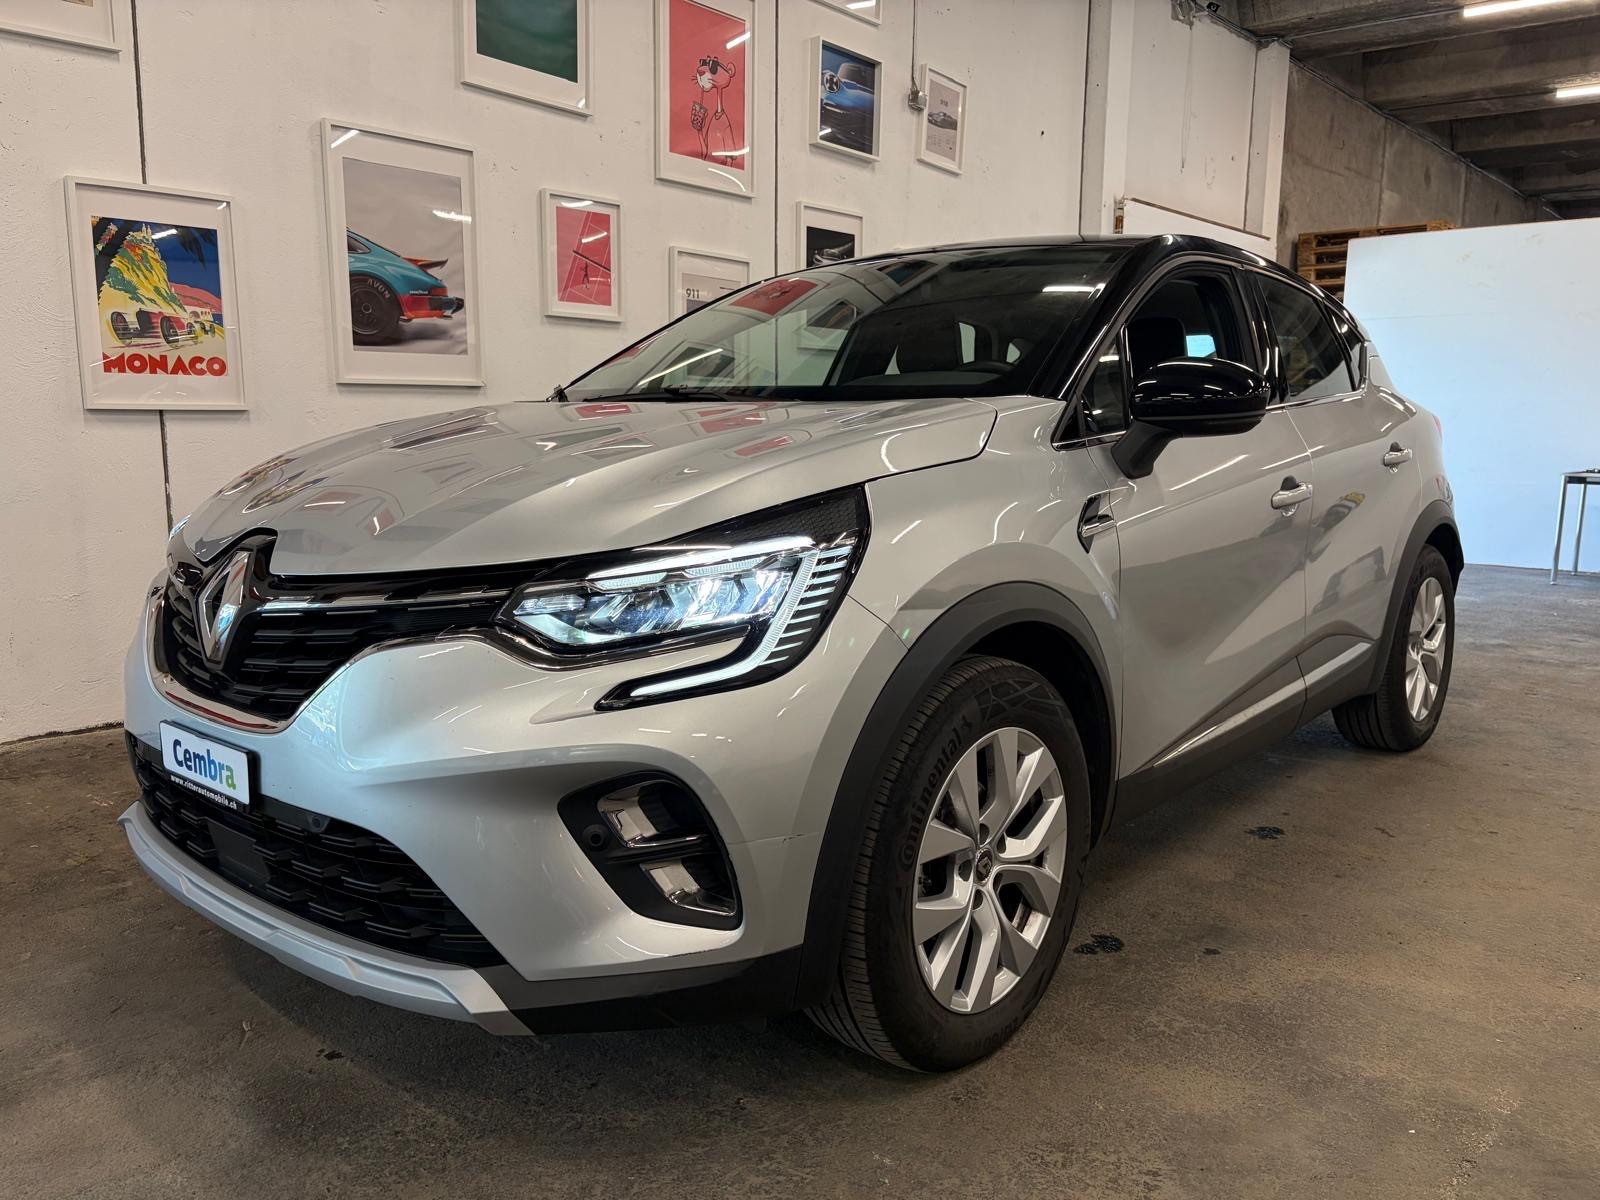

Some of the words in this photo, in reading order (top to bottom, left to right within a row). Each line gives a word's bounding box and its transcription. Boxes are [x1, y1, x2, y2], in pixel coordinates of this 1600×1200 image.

[367, 279, 391, 299] AVON
[686, 288, 699, 299] 911
[102, 352, 227, 376] MONACO
[173, 739, 237, 790] Cembra
